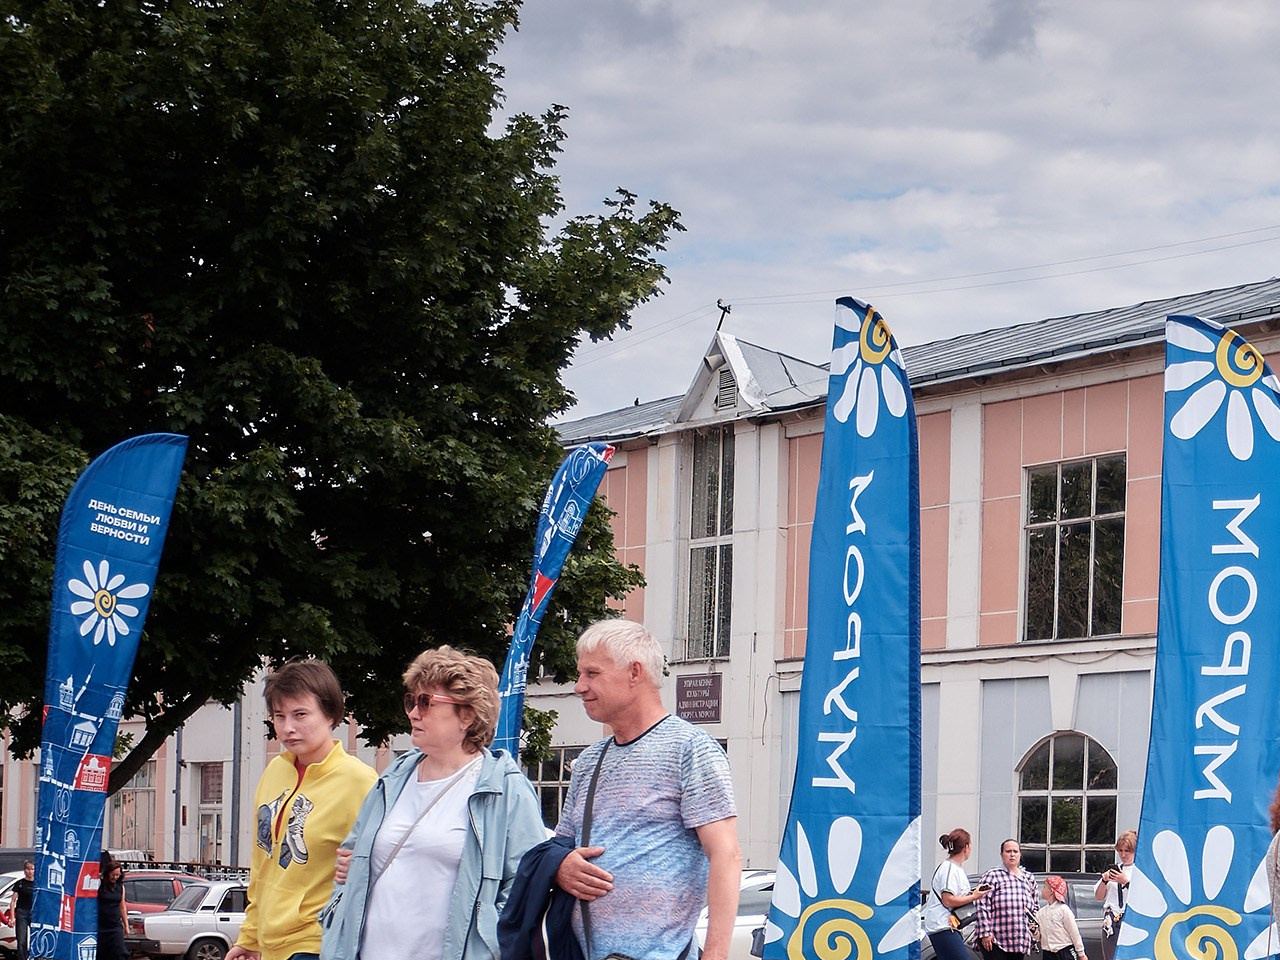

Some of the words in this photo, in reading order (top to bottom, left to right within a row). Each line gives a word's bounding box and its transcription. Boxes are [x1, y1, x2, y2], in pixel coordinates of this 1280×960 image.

[88, 499, 117, 514] ДЕНЬ
[90, 523, 150, 545] ВЕРНОСТИ
[96, 512, 136, 531] ЛЮБВИ
[138, 523, 148, 534] И
